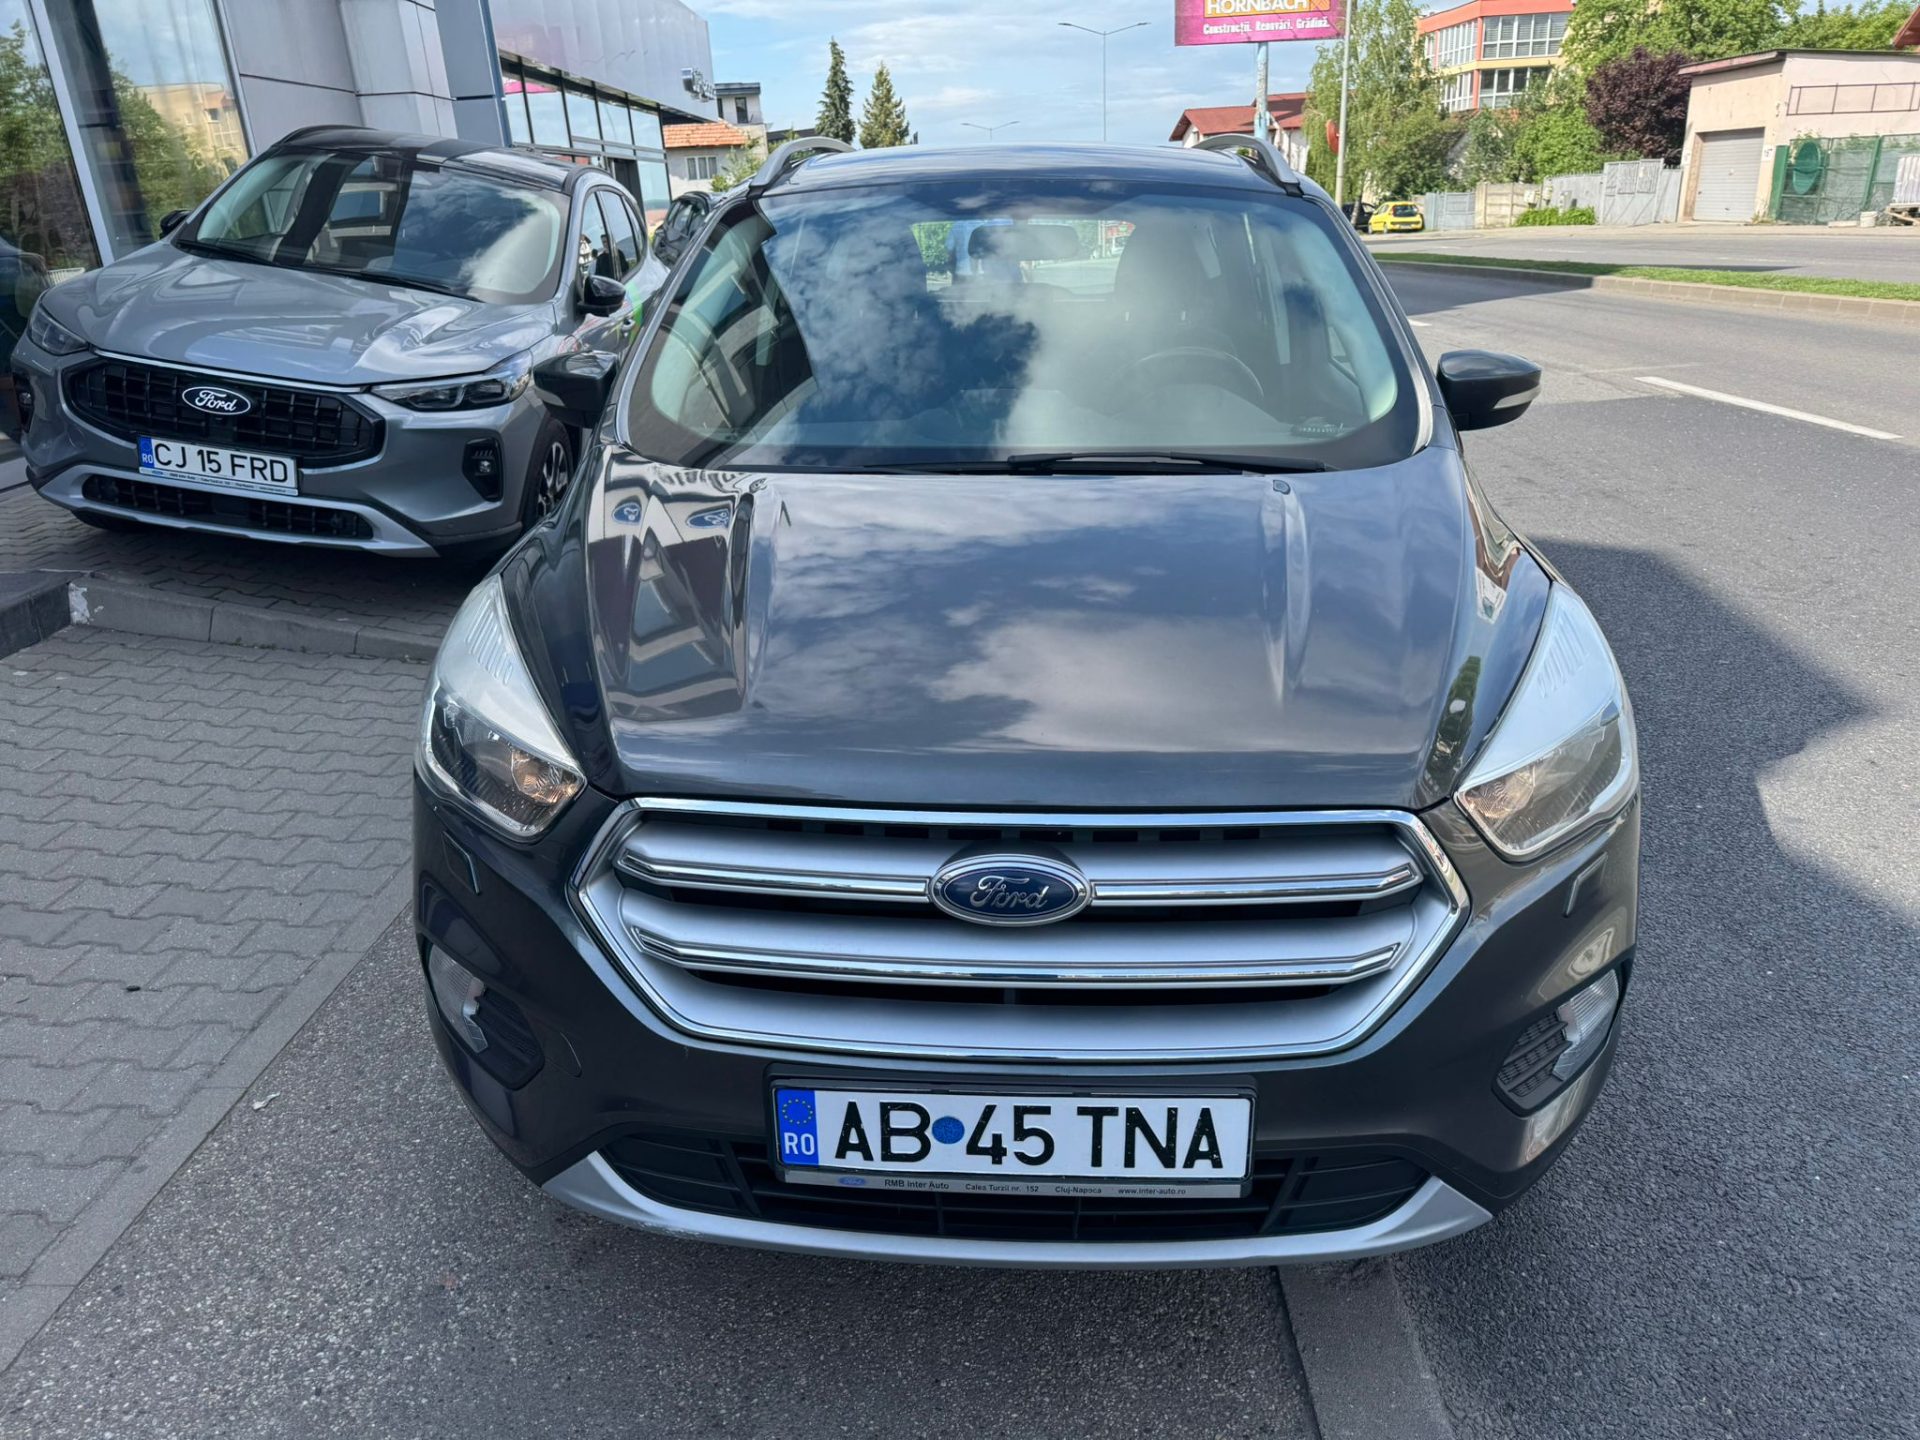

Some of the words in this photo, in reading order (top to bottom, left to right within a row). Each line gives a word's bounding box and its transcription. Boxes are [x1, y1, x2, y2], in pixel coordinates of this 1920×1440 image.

[195, 389, 237, 412] Ford
[142, 453, 153, 464] RO
[154, 443, 187, 468] CJ
[197, 449, 222, 473] 15
[230, 454, 288, 483] FRD
[970, 875, 1049, 909] Ford
[783, 1132, 815, 1155] RO
[835, 1101, 931, 1162] AB
[966, 1104, 1055, 1165] 45
[1076, 1106, 1223, 1169] TNA
[884, 1179, 905, 1187] RMB
[929, 1181, 949, 1190] Auto
